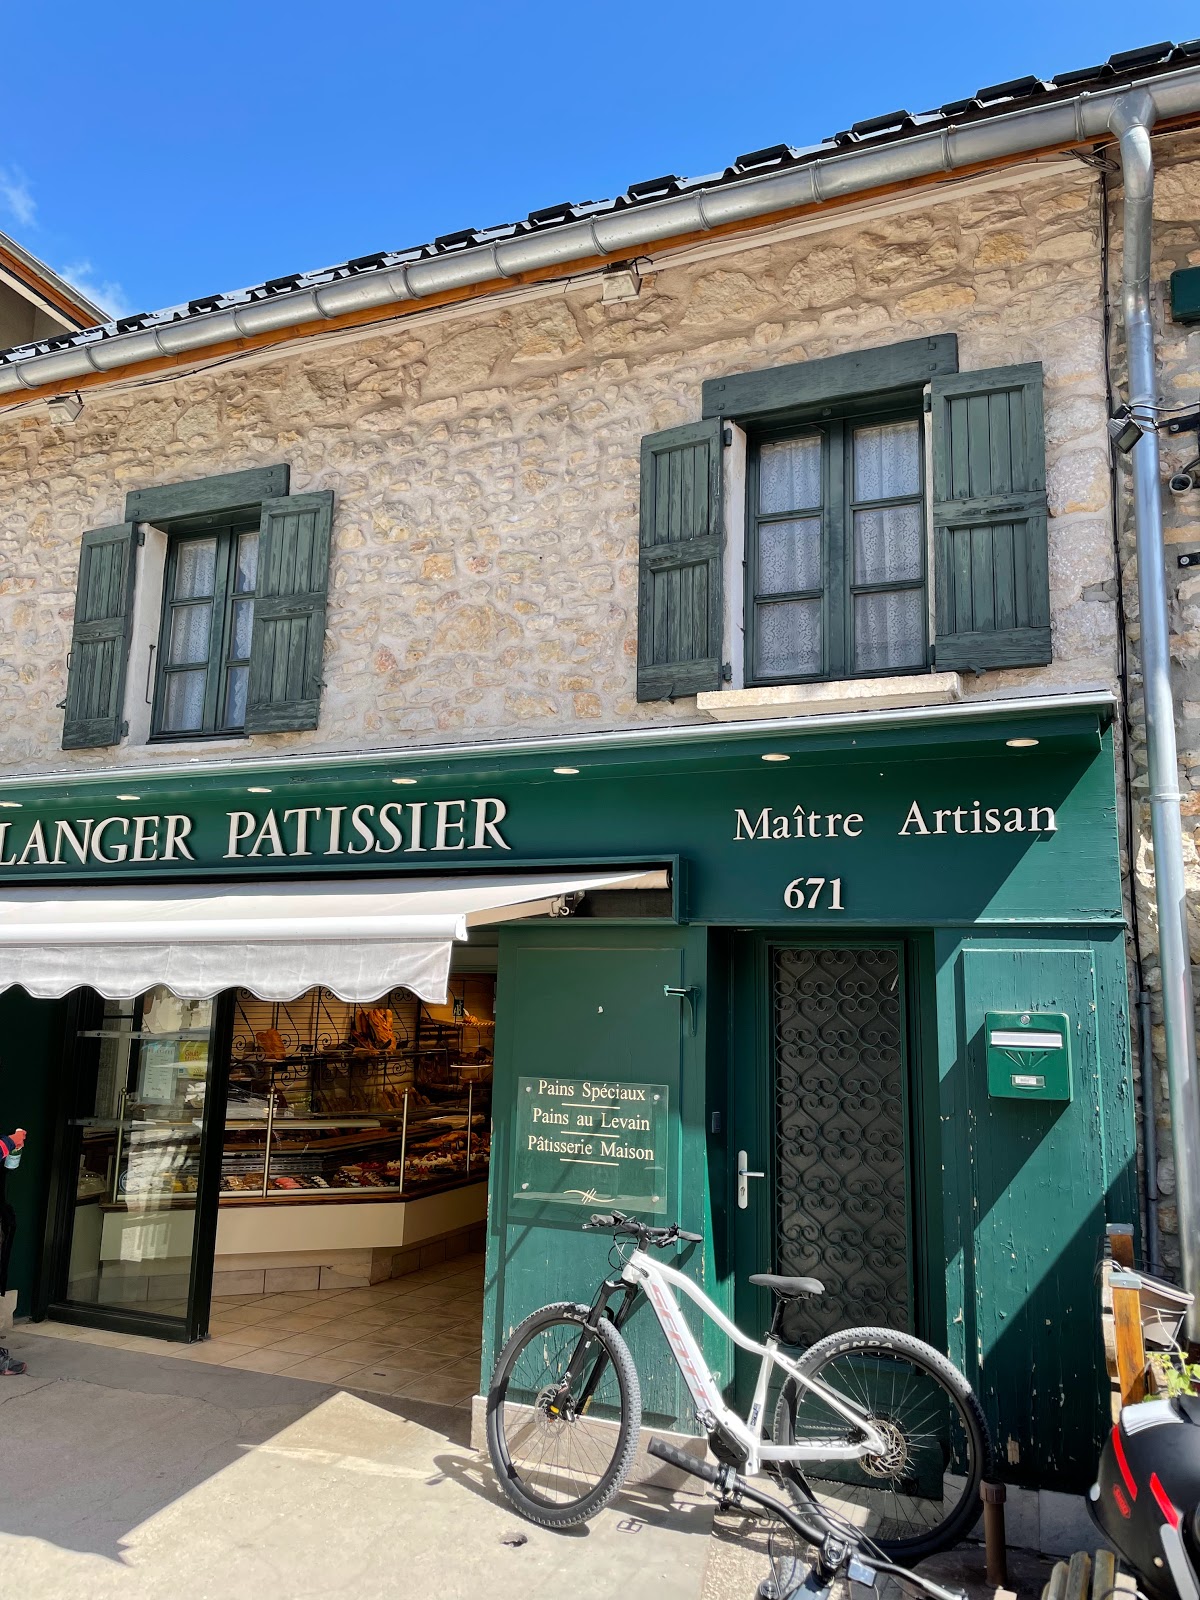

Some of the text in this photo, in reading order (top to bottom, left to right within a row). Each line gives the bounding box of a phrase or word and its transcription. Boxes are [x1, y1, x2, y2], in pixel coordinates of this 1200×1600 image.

[223, 798, 511, 859] PATISSIER
[734, 800, 1058, 840] Maître Artisan
[784, 877, 845, 910] 671
[538, 1080, 646, 1102] Pains Spéciaux
[533, 1108, 650, 1131] Pains au Levain
[528, 1135, 654, 1160] Pâtisserie Maison
[825, 1340, 893, 1358] KENDA
